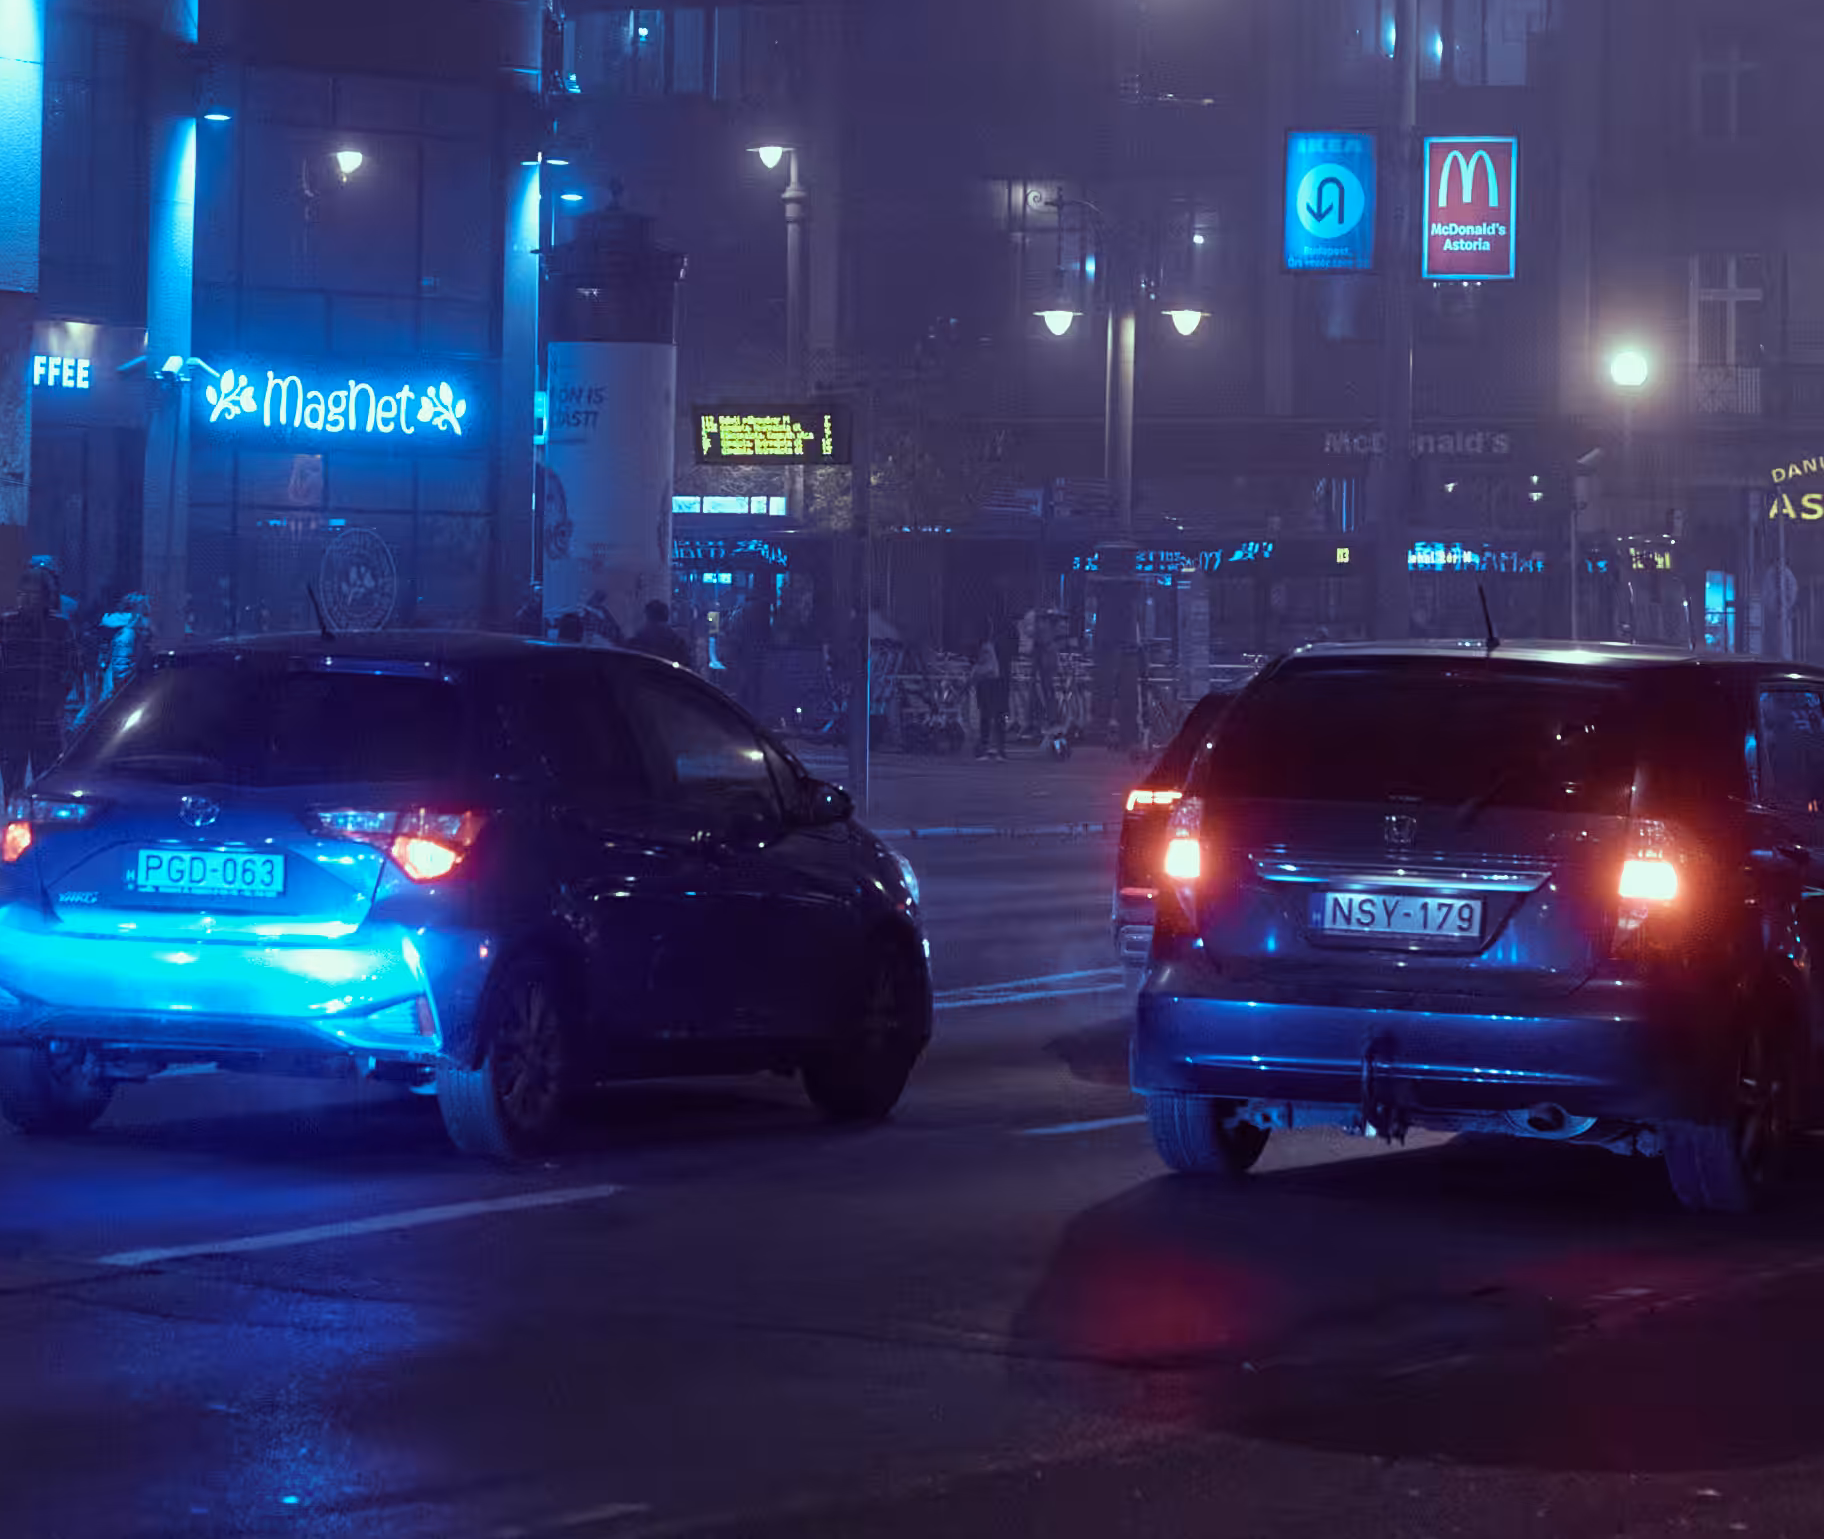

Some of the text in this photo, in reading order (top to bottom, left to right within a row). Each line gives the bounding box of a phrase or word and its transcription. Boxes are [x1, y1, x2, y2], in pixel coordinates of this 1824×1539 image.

[1430, 222, 1507, 237] McDonald's
[1443, 238, 1491, 251] Astoria
[33, 355, 90, 389] FFEE
[263, 370, 416, 434] MagNet
[1324, 428, 1510, 454] McDnald's
[144, 854, 276, 888] PGD-063
[1331, 897, 1475, 933] NSY-179
